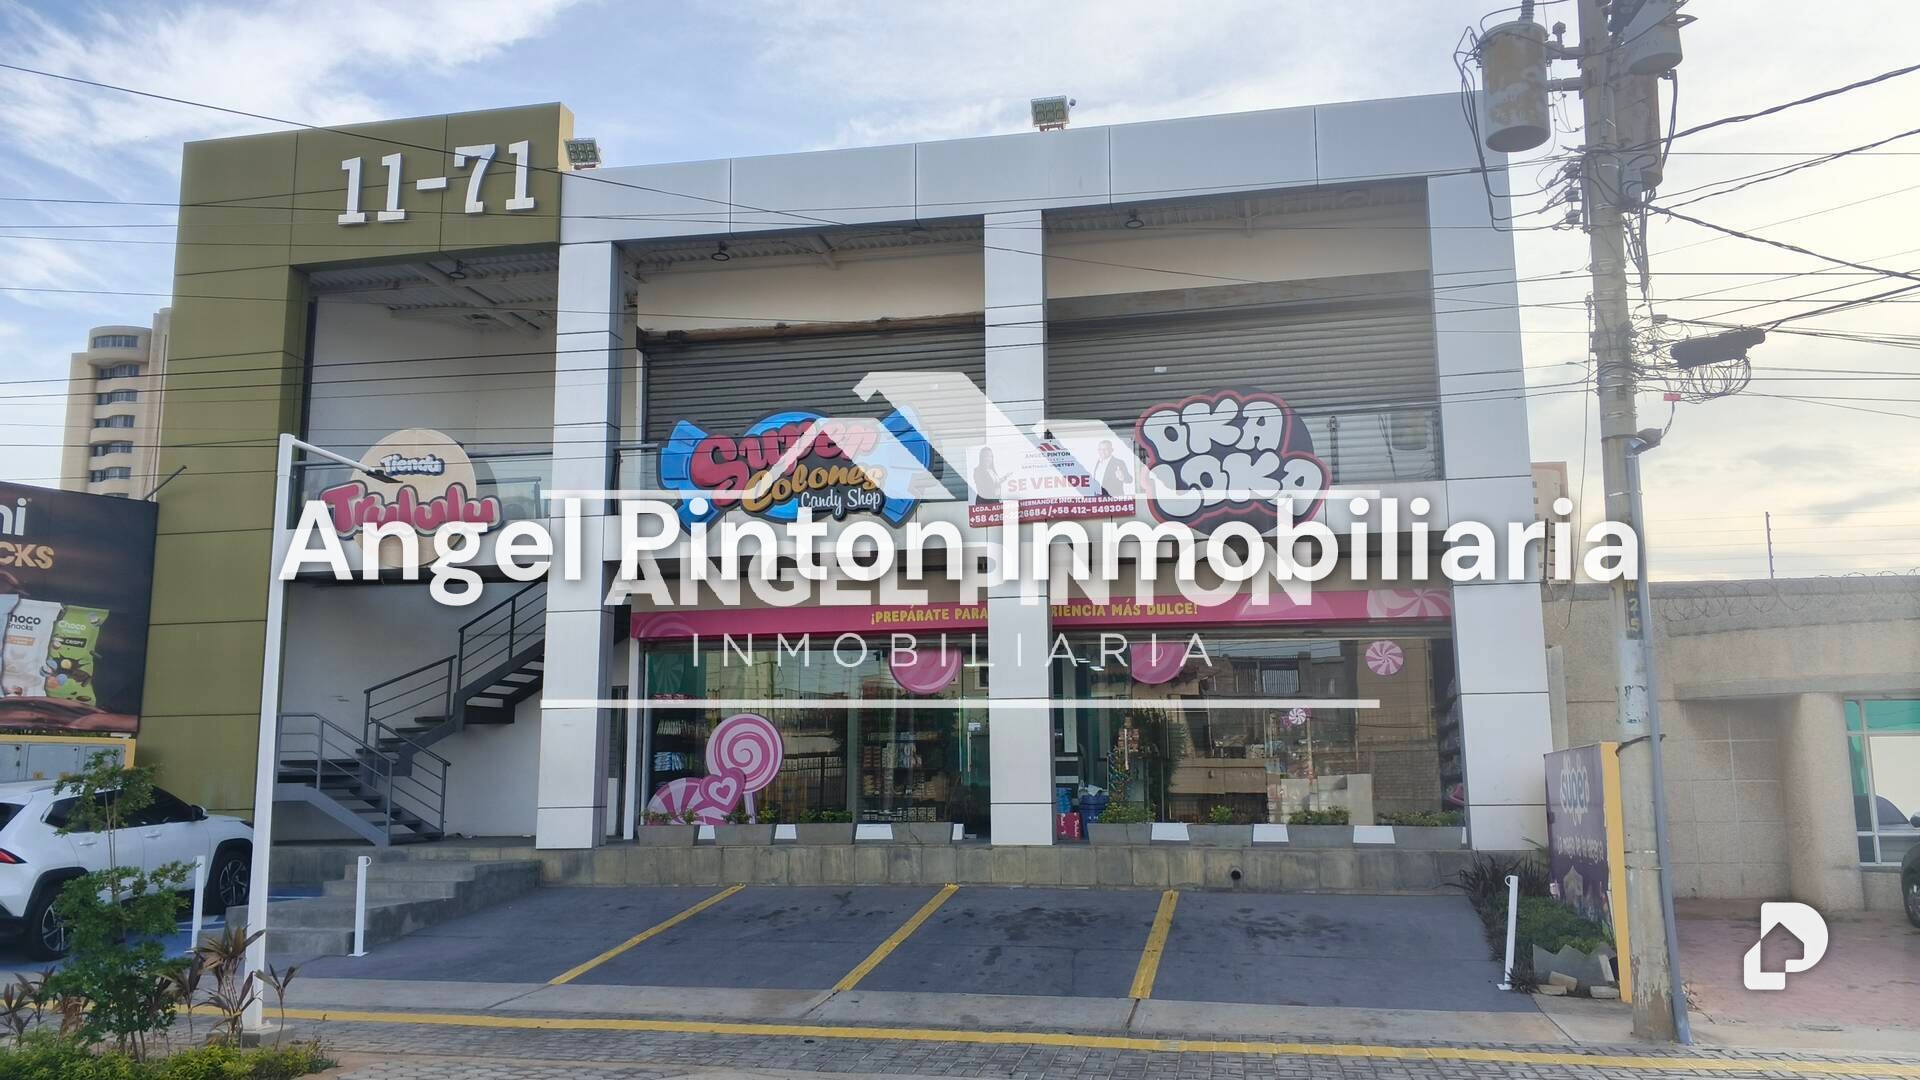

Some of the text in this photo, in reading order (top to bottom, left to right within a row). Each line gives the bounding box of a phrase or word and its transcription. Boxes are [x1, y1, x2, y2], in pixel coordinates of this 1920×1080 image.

[338, 140, 535, 225] 11-71
[1143, 398, 1283, 462] OKA
[380, 454, 444, 476] Tienda
[690, 419, 879, 507] Super
[1008, 475, 1090, 492] SE VENDE
[1148, 451, 1323, 518] LOKA
[320, 480, 501, 538] Trululu
[801, 488, 881, 517] Candy Shop
[1070, 503, 1135, 514] 412-5493045
[871, 604, 950, 625] ¡PREPÁRATE
[1051, 605, 1106, 617] RIENCIA
[1111, 598, 1141, 616] MÁS
